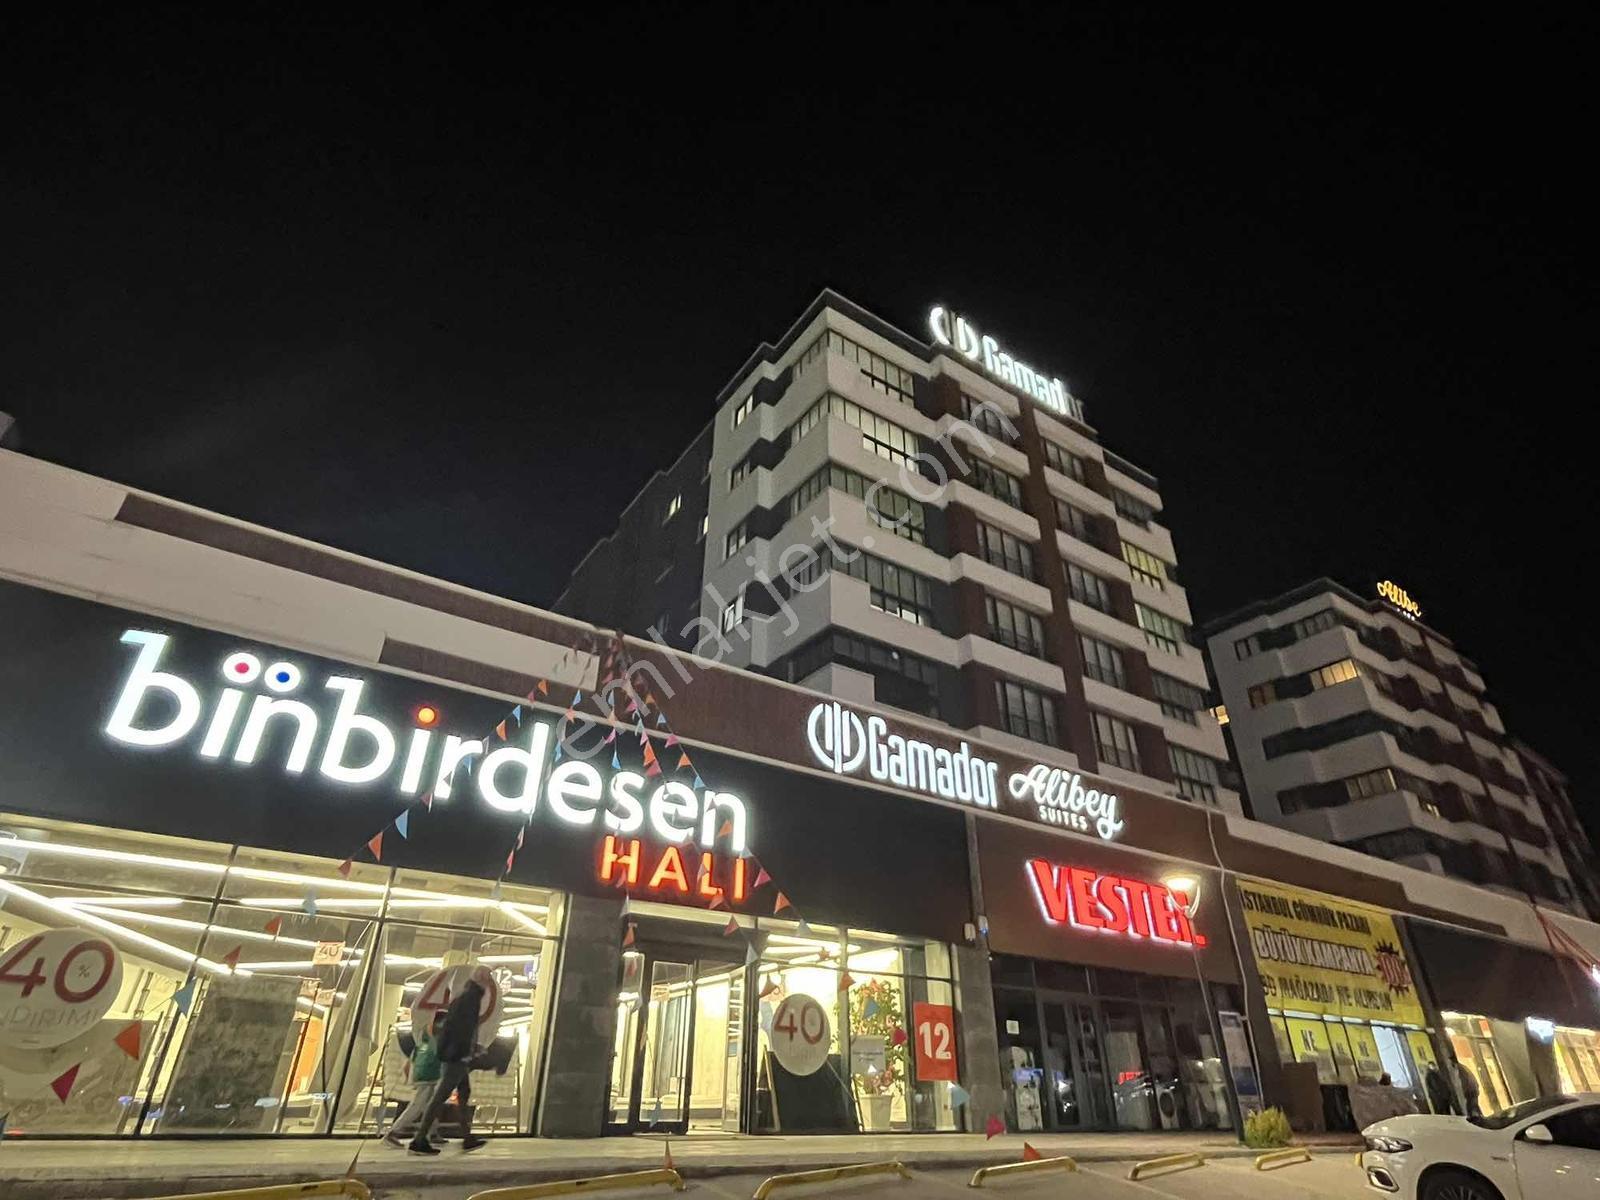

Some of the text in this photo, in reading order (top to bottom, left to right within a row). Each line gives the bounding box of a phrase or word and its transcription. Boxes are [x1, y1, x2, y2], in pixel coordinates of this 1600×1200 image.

[104, 629, 748, 851] binbirdesen
[866, 715, 998, 809] Gamador
[1008, 763, 1125, 840] Alibey
[1038, 804, 1088, 830] SUITES
[600, 834, 745, 900] HALI
[1025, 858, 1207, 947] VESTEL
[0, 935, 115, 1003] 40
[774, 1000, 824, 1045] 40
[919, 1021, 952, 1060] 12
